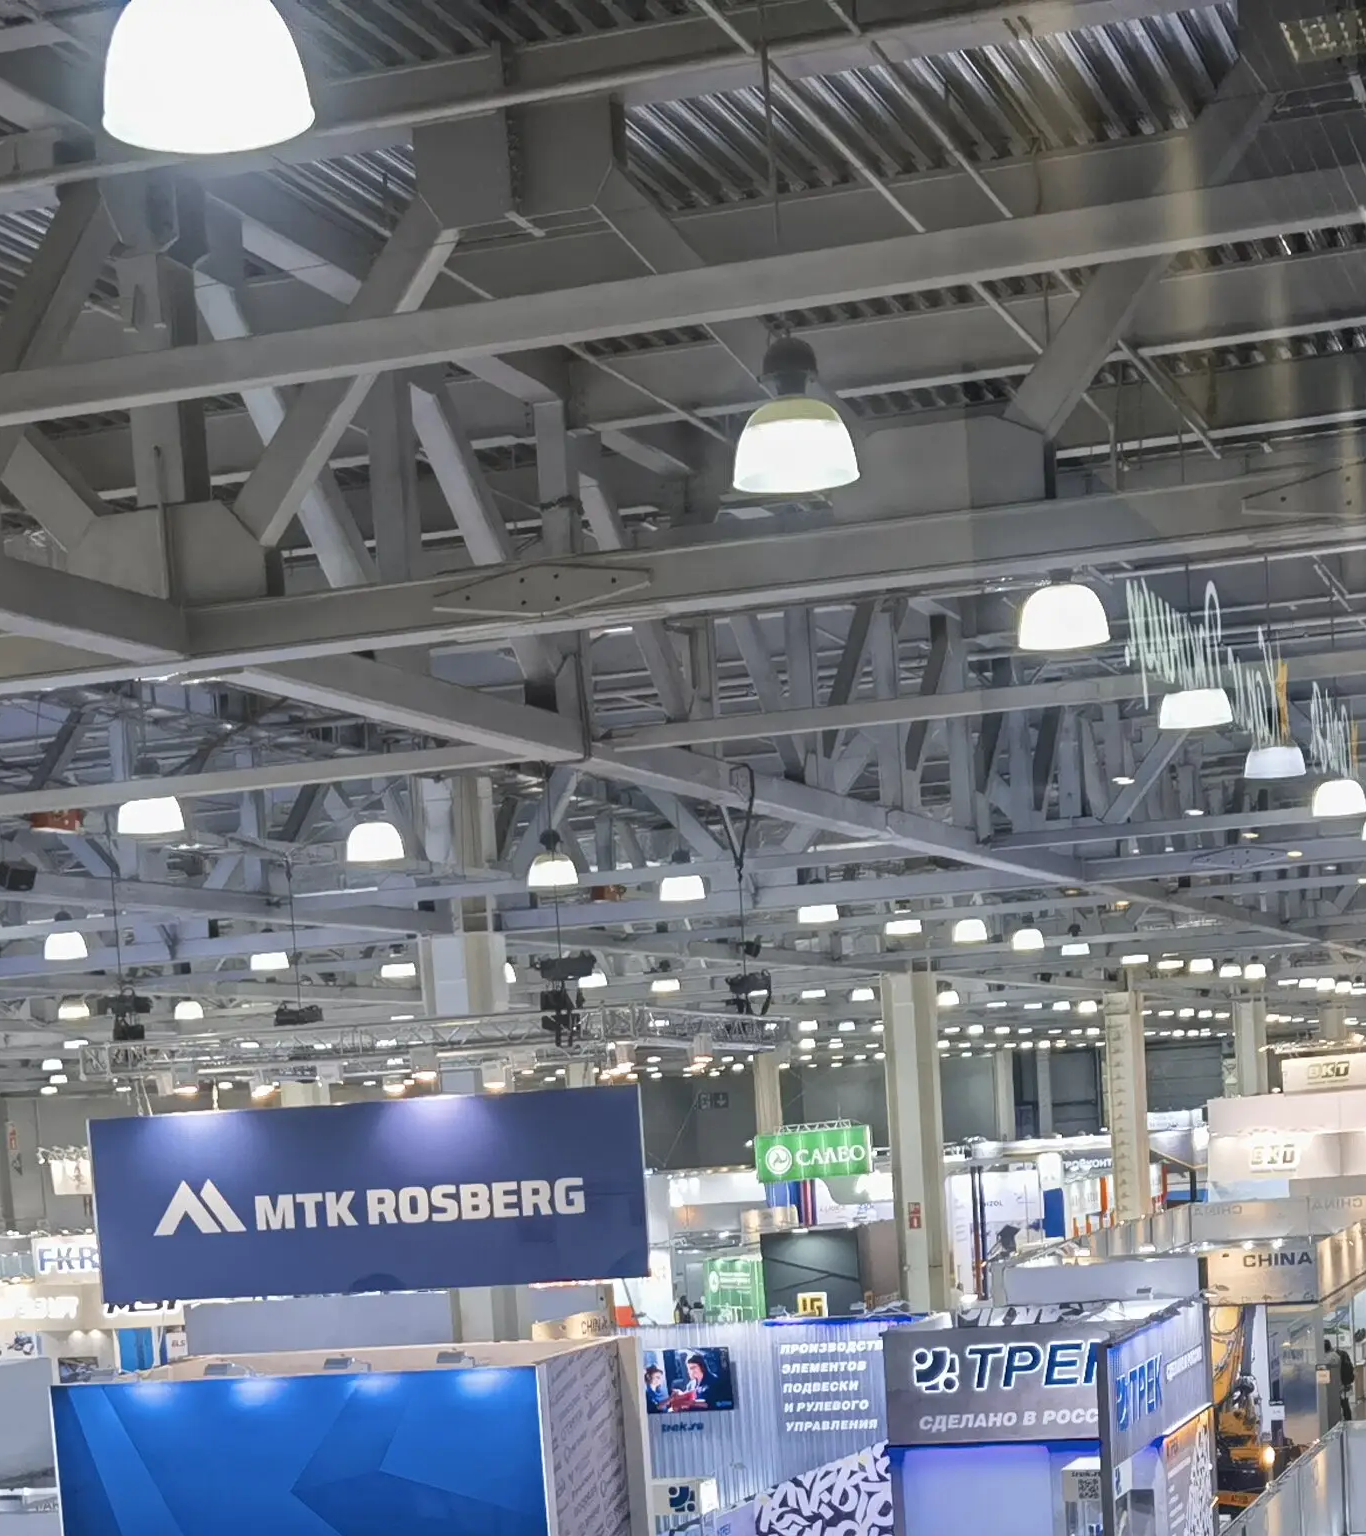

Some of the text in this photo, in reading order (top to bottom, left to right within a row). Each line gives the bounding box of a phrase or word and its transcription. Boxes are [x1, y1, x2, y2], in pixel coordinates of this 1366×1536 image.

[255, 1177, 585, 1231] MTK ROSBERG
[38, 1246, 100, 1272] FKR
[1242, 1251, 1313, 1268] CHINA
[780, 1340, 884, 1355] ПРОИЗВОДСТВ
[782, 1361, 867, 1375] ЭЛЕМЕНТОВ
[784, 1380, 859, 1394] ПОДВЕСКИ
[785, 1399, 870, 1412] И РУЛЕВОГО
[786, 1419, 878, 1432] УПРАВЛЕНИЯ
[919, 1408, 1099, 1432] СДЕЛАНО В РОСС
